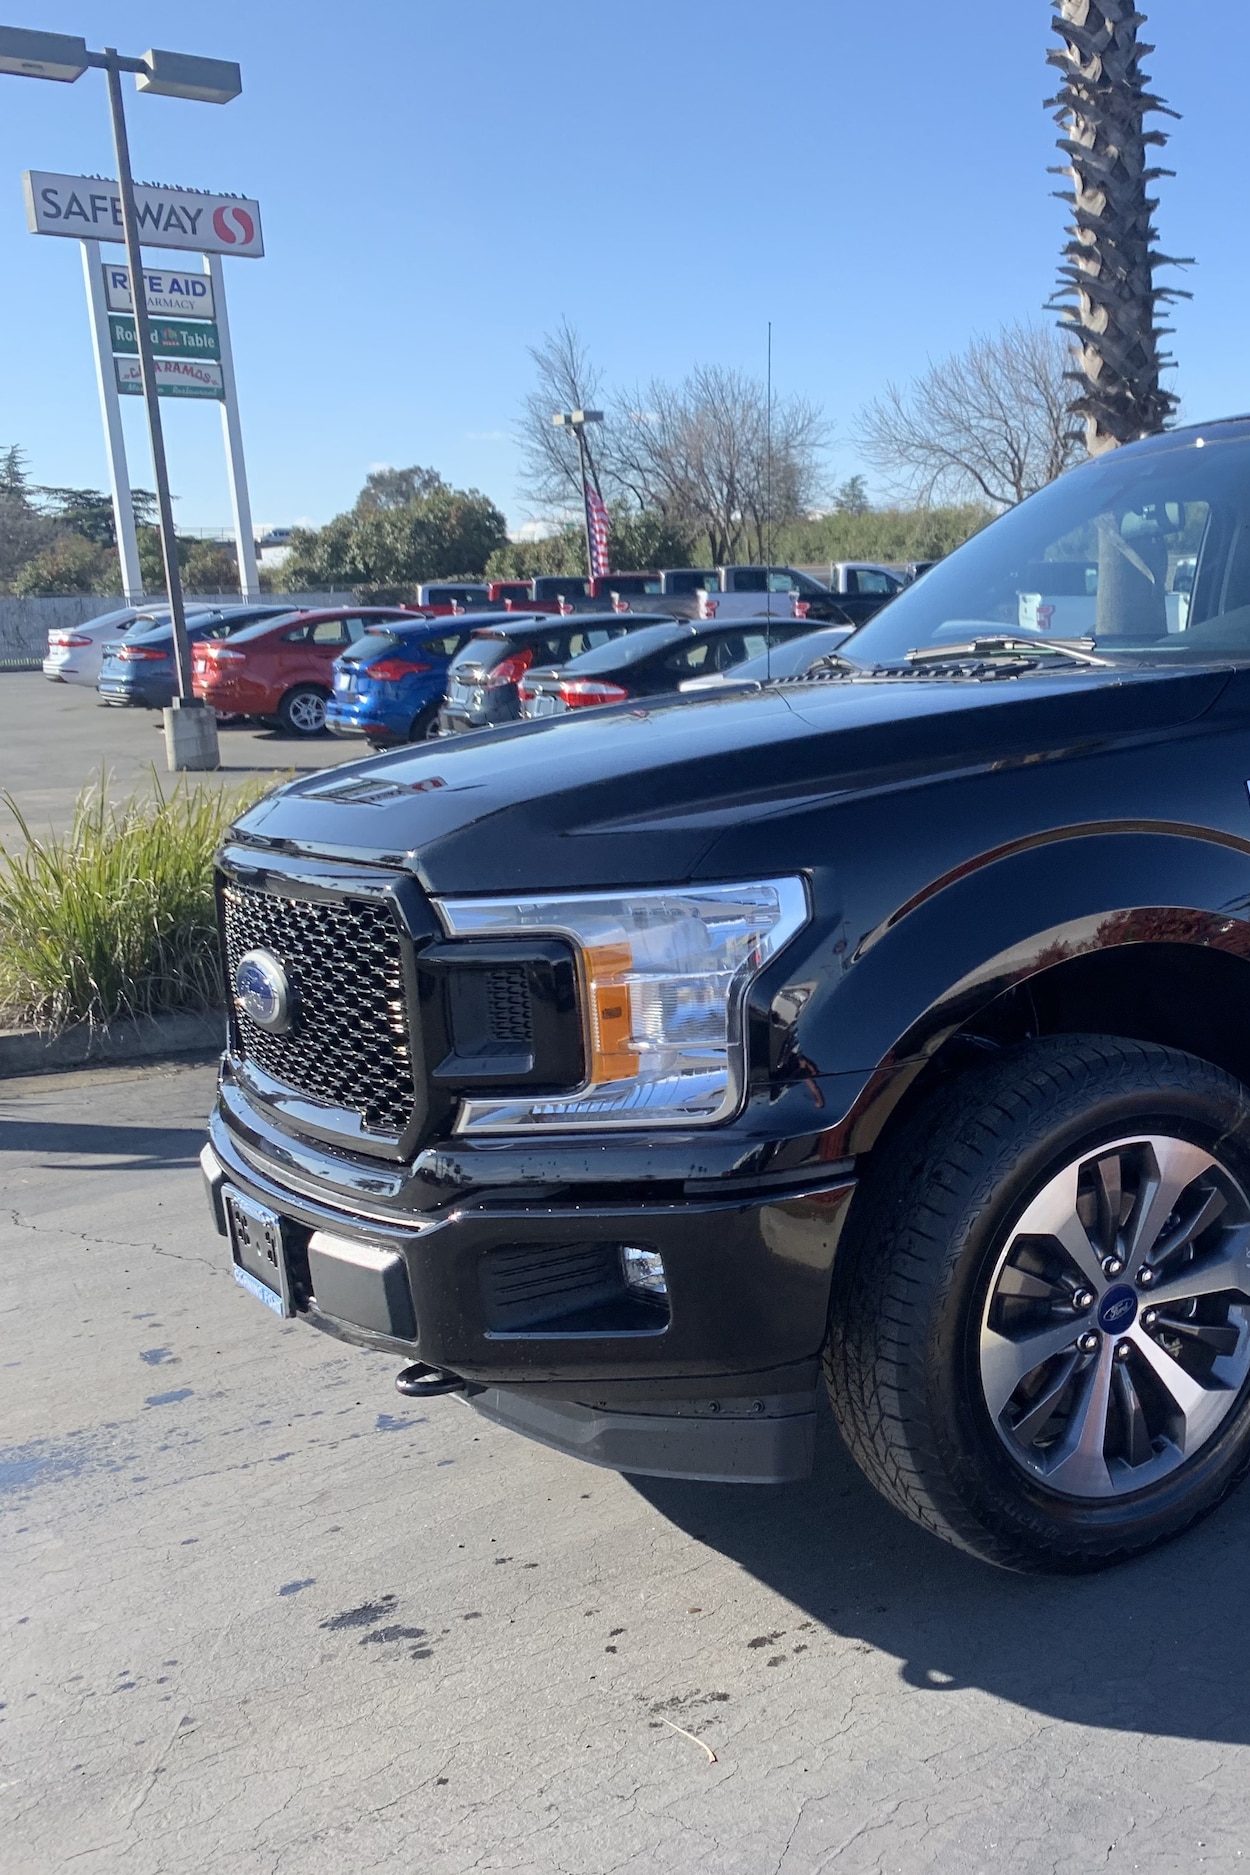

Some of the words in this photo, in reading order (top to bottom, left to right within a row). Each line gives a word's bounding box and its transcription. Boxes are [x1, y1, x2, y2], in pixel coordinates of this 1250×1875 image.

[111, 271, 163, 293] RE
[168, 278, 207, 297] AID
[128, 291, 196, 311] ARMACY
[115, 325, 159, 344] Rod
[180, 330, 216, 348] Table
[129, 361, 162, 379] CA
[164, 361, 211, 384] RAMOS
